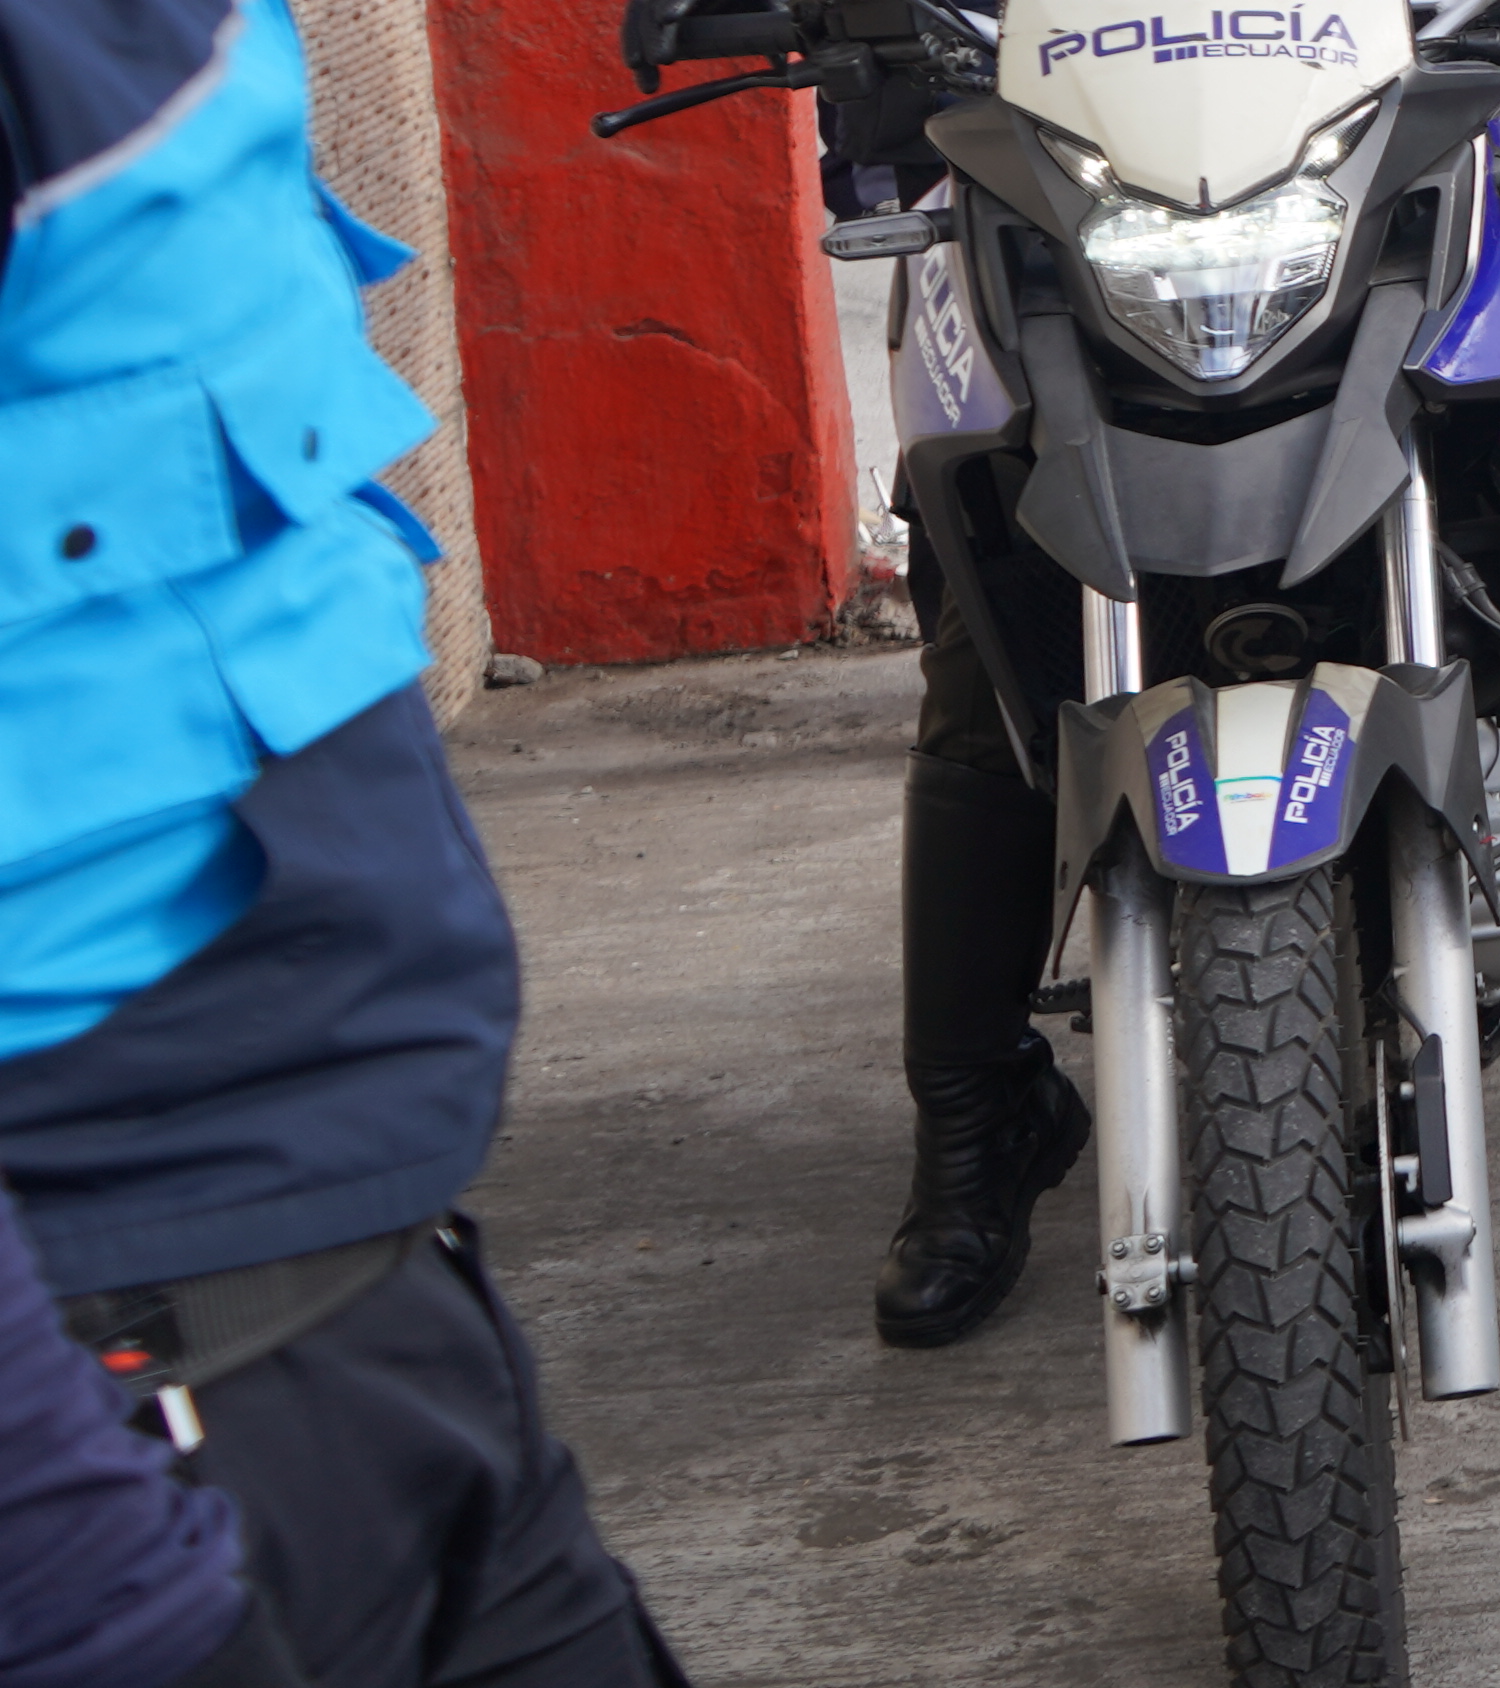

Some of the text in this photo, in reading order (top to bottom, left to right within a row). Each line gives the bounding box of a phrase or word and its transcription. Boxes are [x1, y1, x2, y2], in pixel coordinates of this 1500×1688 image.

[1038, 3, 1358, 77] POLICÍA
[1203, 43, 1358, 68] ECUADOR
[919, 244, 974, 404] OLICÍA
[1165, 730, 1204, 833] POLICÍA
[1283, 726, 1336, 824] POLICÍA
